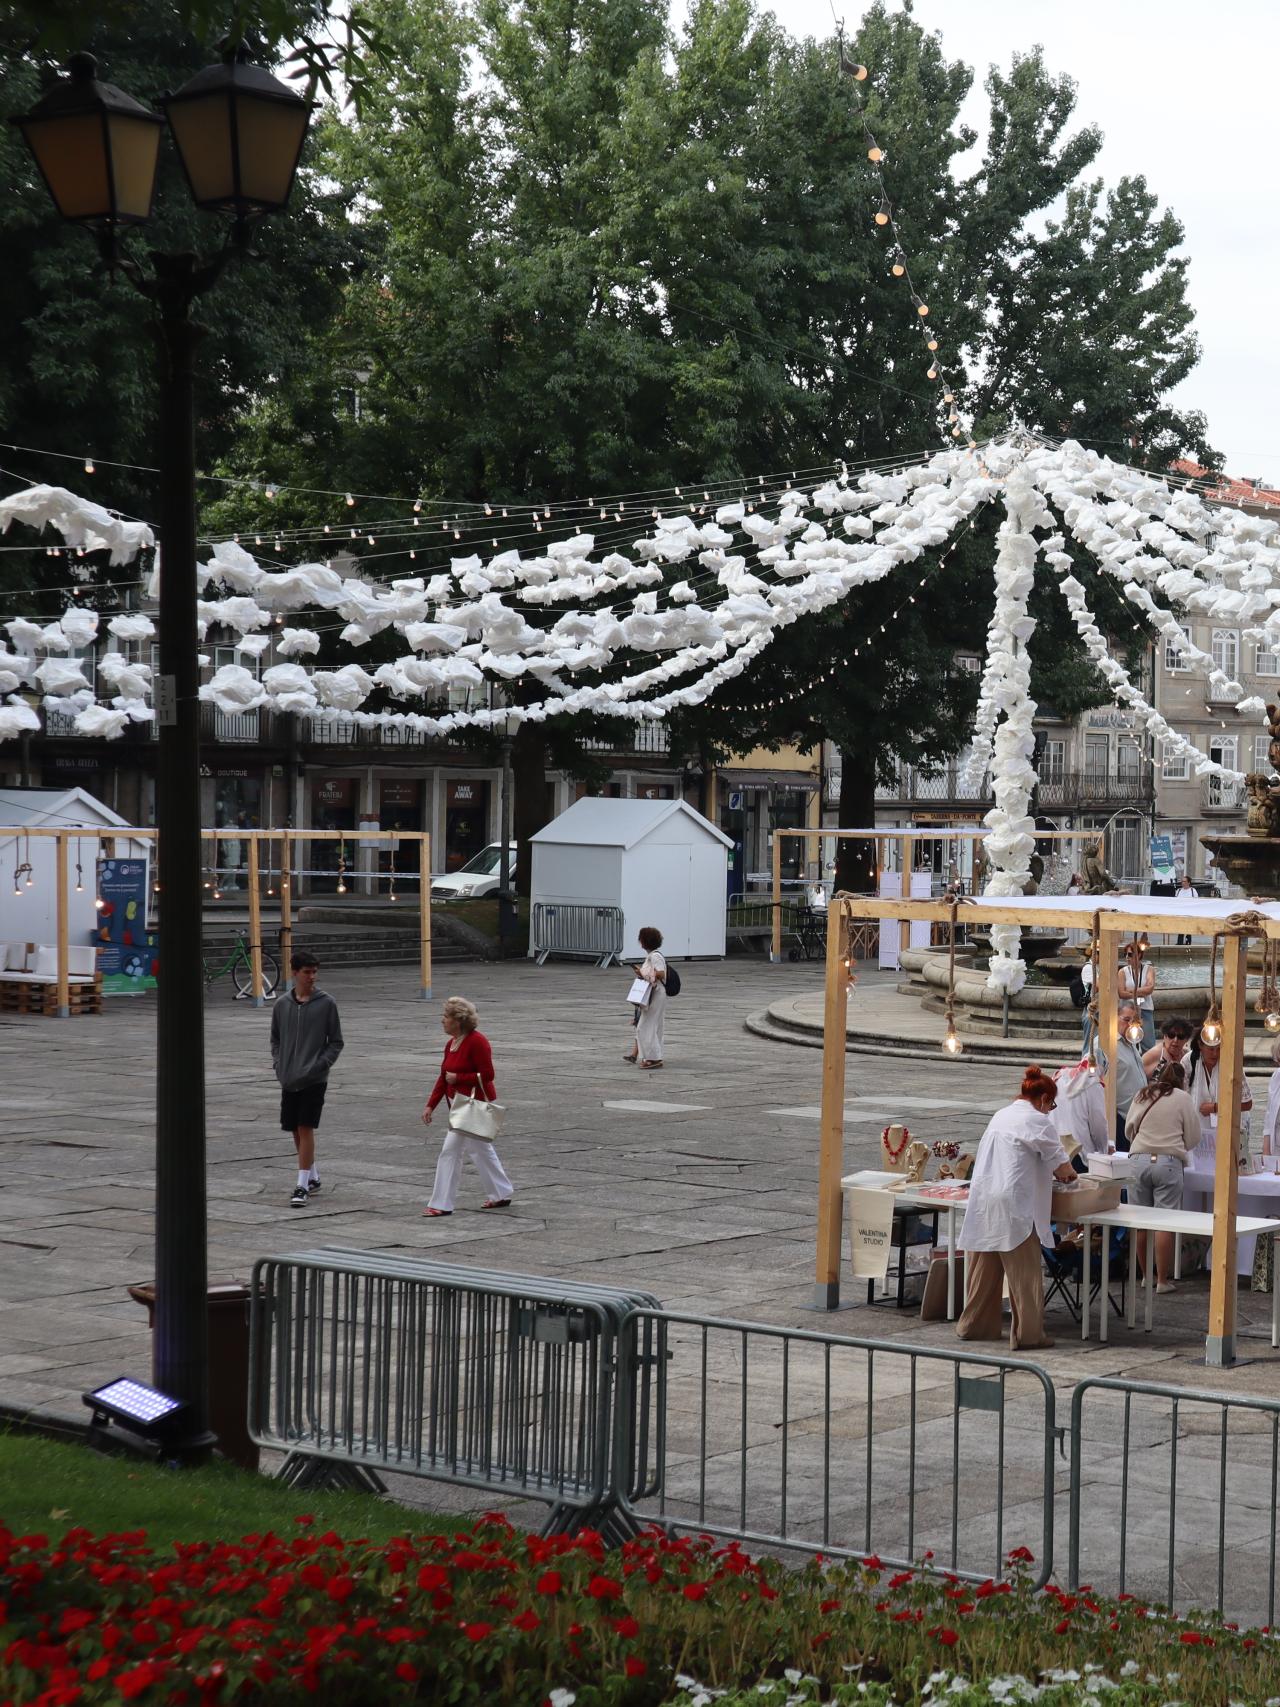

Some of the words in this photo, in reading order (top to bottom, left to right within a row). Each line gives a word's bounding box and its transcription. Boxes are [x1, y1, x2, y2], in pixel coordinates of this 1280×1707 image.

[160, 694, 168, 706] 2
[159, 710, 169, 721] 11
[454, 791, 473, 799] AWAY
[858, 1228, 888, 1238] VALENTINA
[863, 1238, 884, 1246] STUDIO
